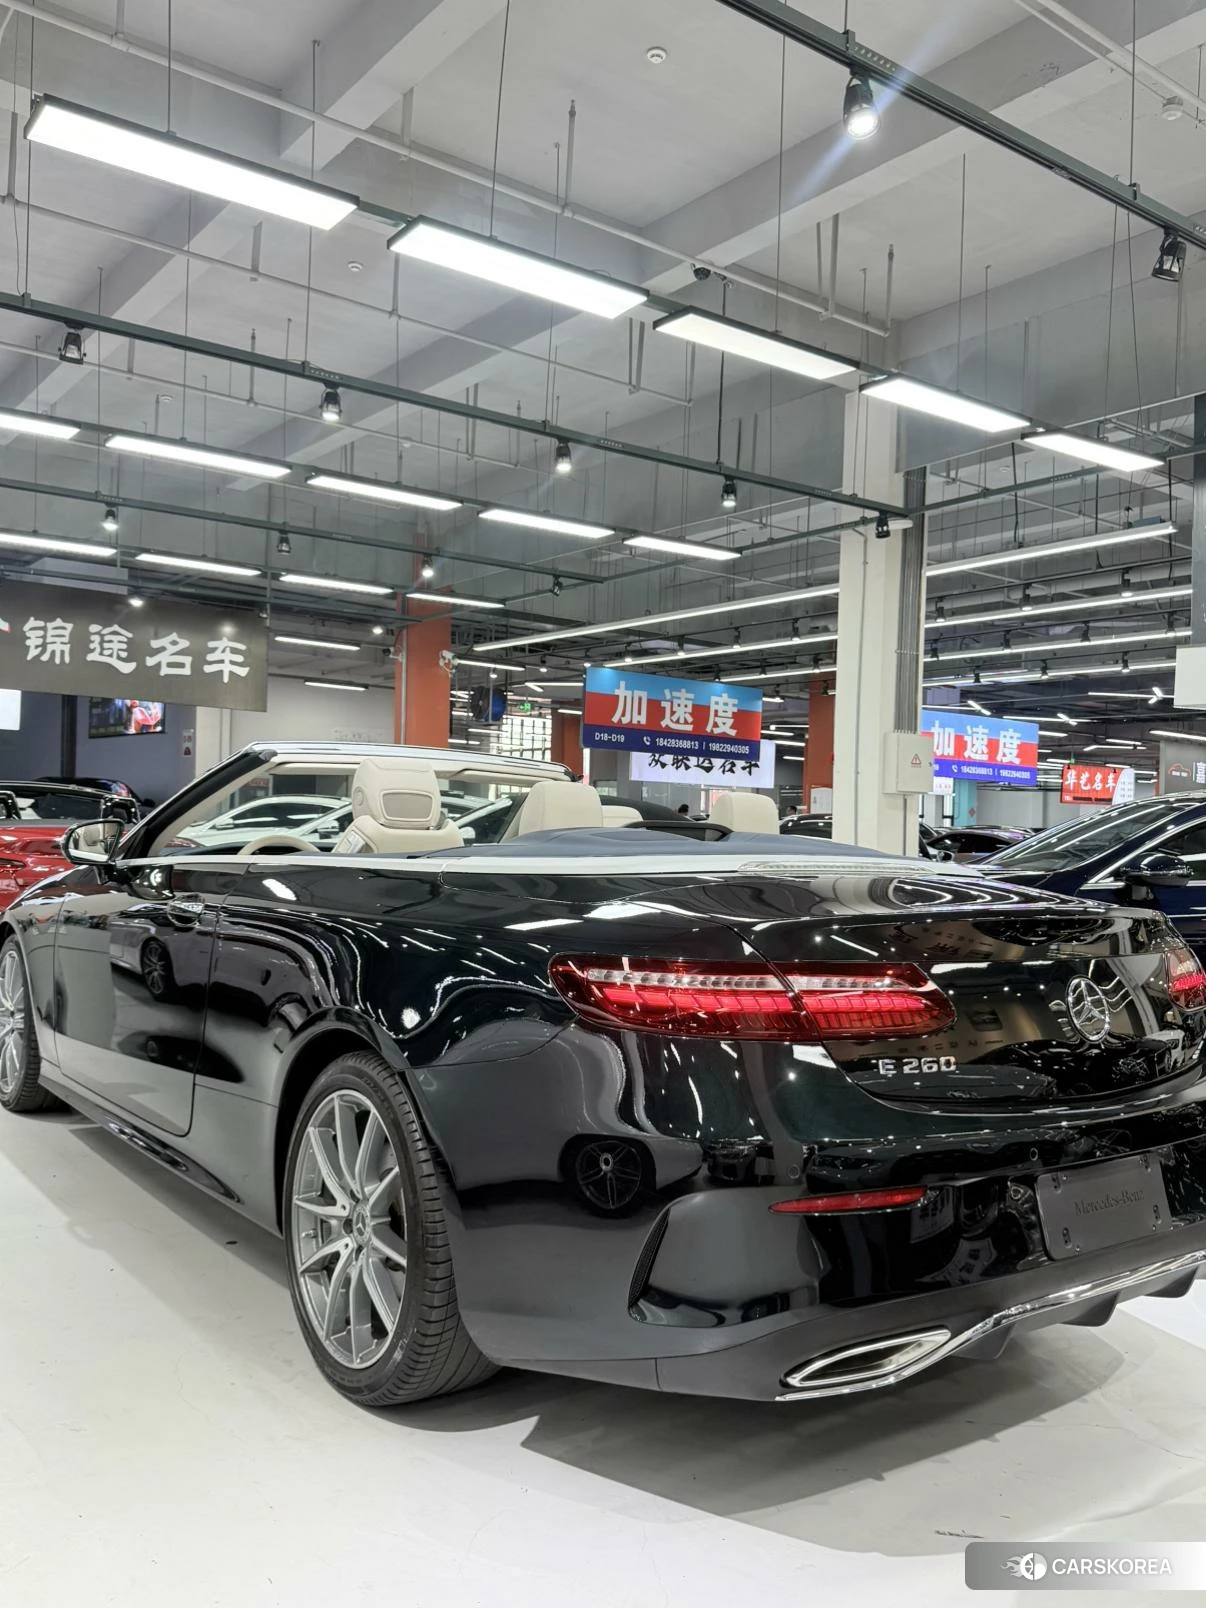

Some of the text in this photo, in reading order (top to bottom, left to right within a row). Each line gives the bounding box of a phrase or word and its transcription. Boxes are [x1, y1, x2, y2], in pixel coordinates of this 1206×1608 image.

[23, 616, 250, 683] 锦途名车
[611, 680, 738, 737] 加速度
[931, 719, 1023, 765] 加速度
[1064, 769, 1116, 792] 华艺名车
[879, 1056, 957, 1075] E 260
[1073, 1189, 1145, 1216] Mercedes-Benz
